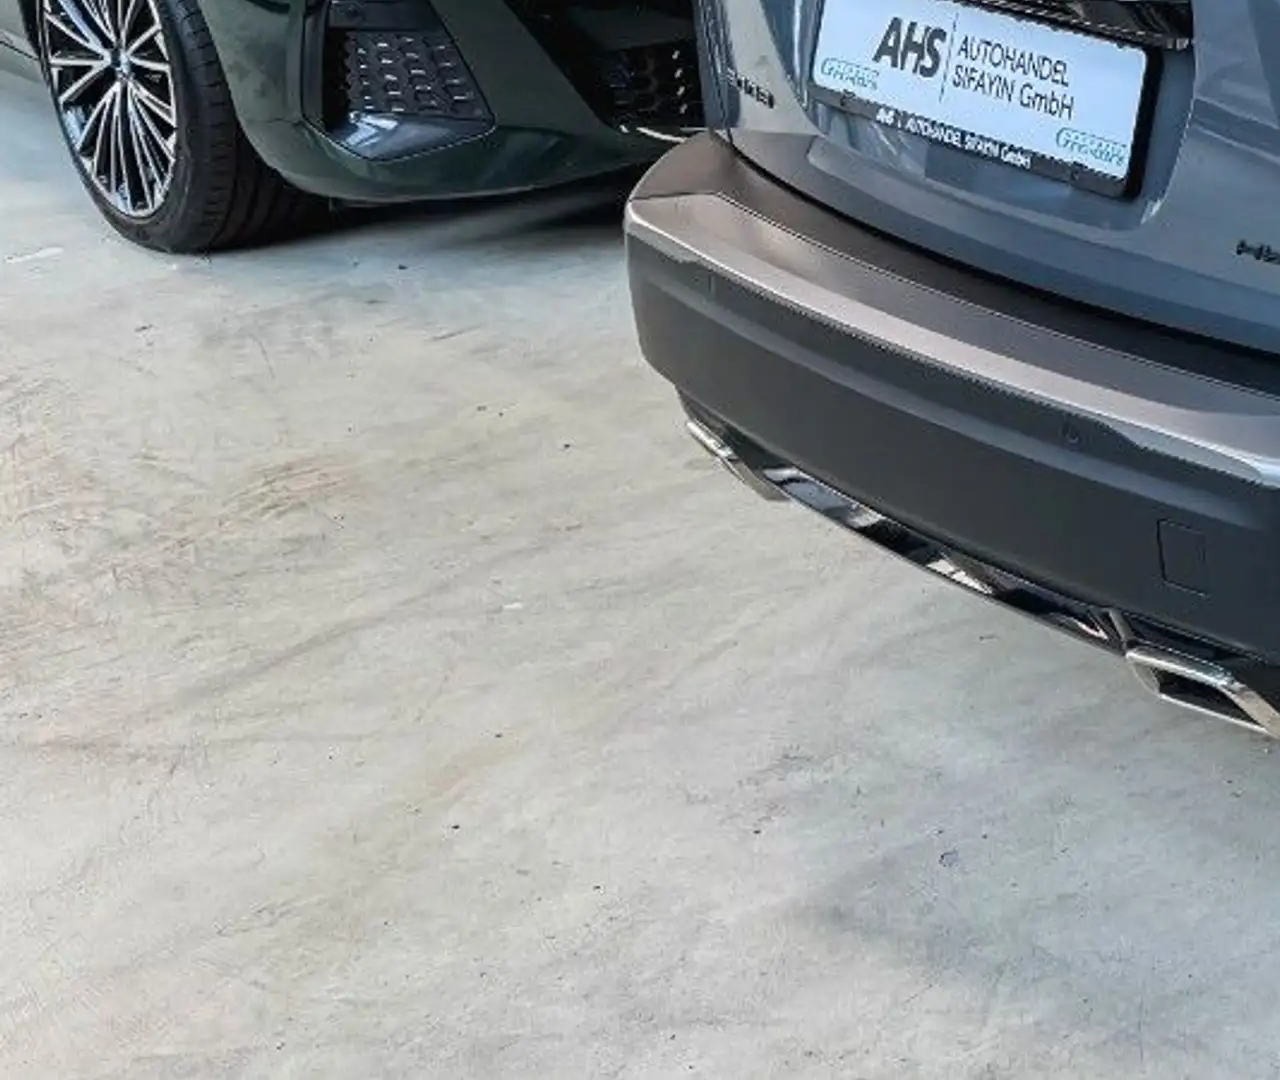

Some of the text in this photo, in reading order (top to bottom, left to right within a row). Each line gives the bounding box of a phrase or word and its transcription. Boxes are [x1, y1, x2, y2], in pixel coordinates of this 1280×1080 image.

[873, 17, 947, 78] AHS
[957, 35, 1070, 88] AUTOHANDEL
[952, 65, 1075, 120] SIFAYIN GmbH
